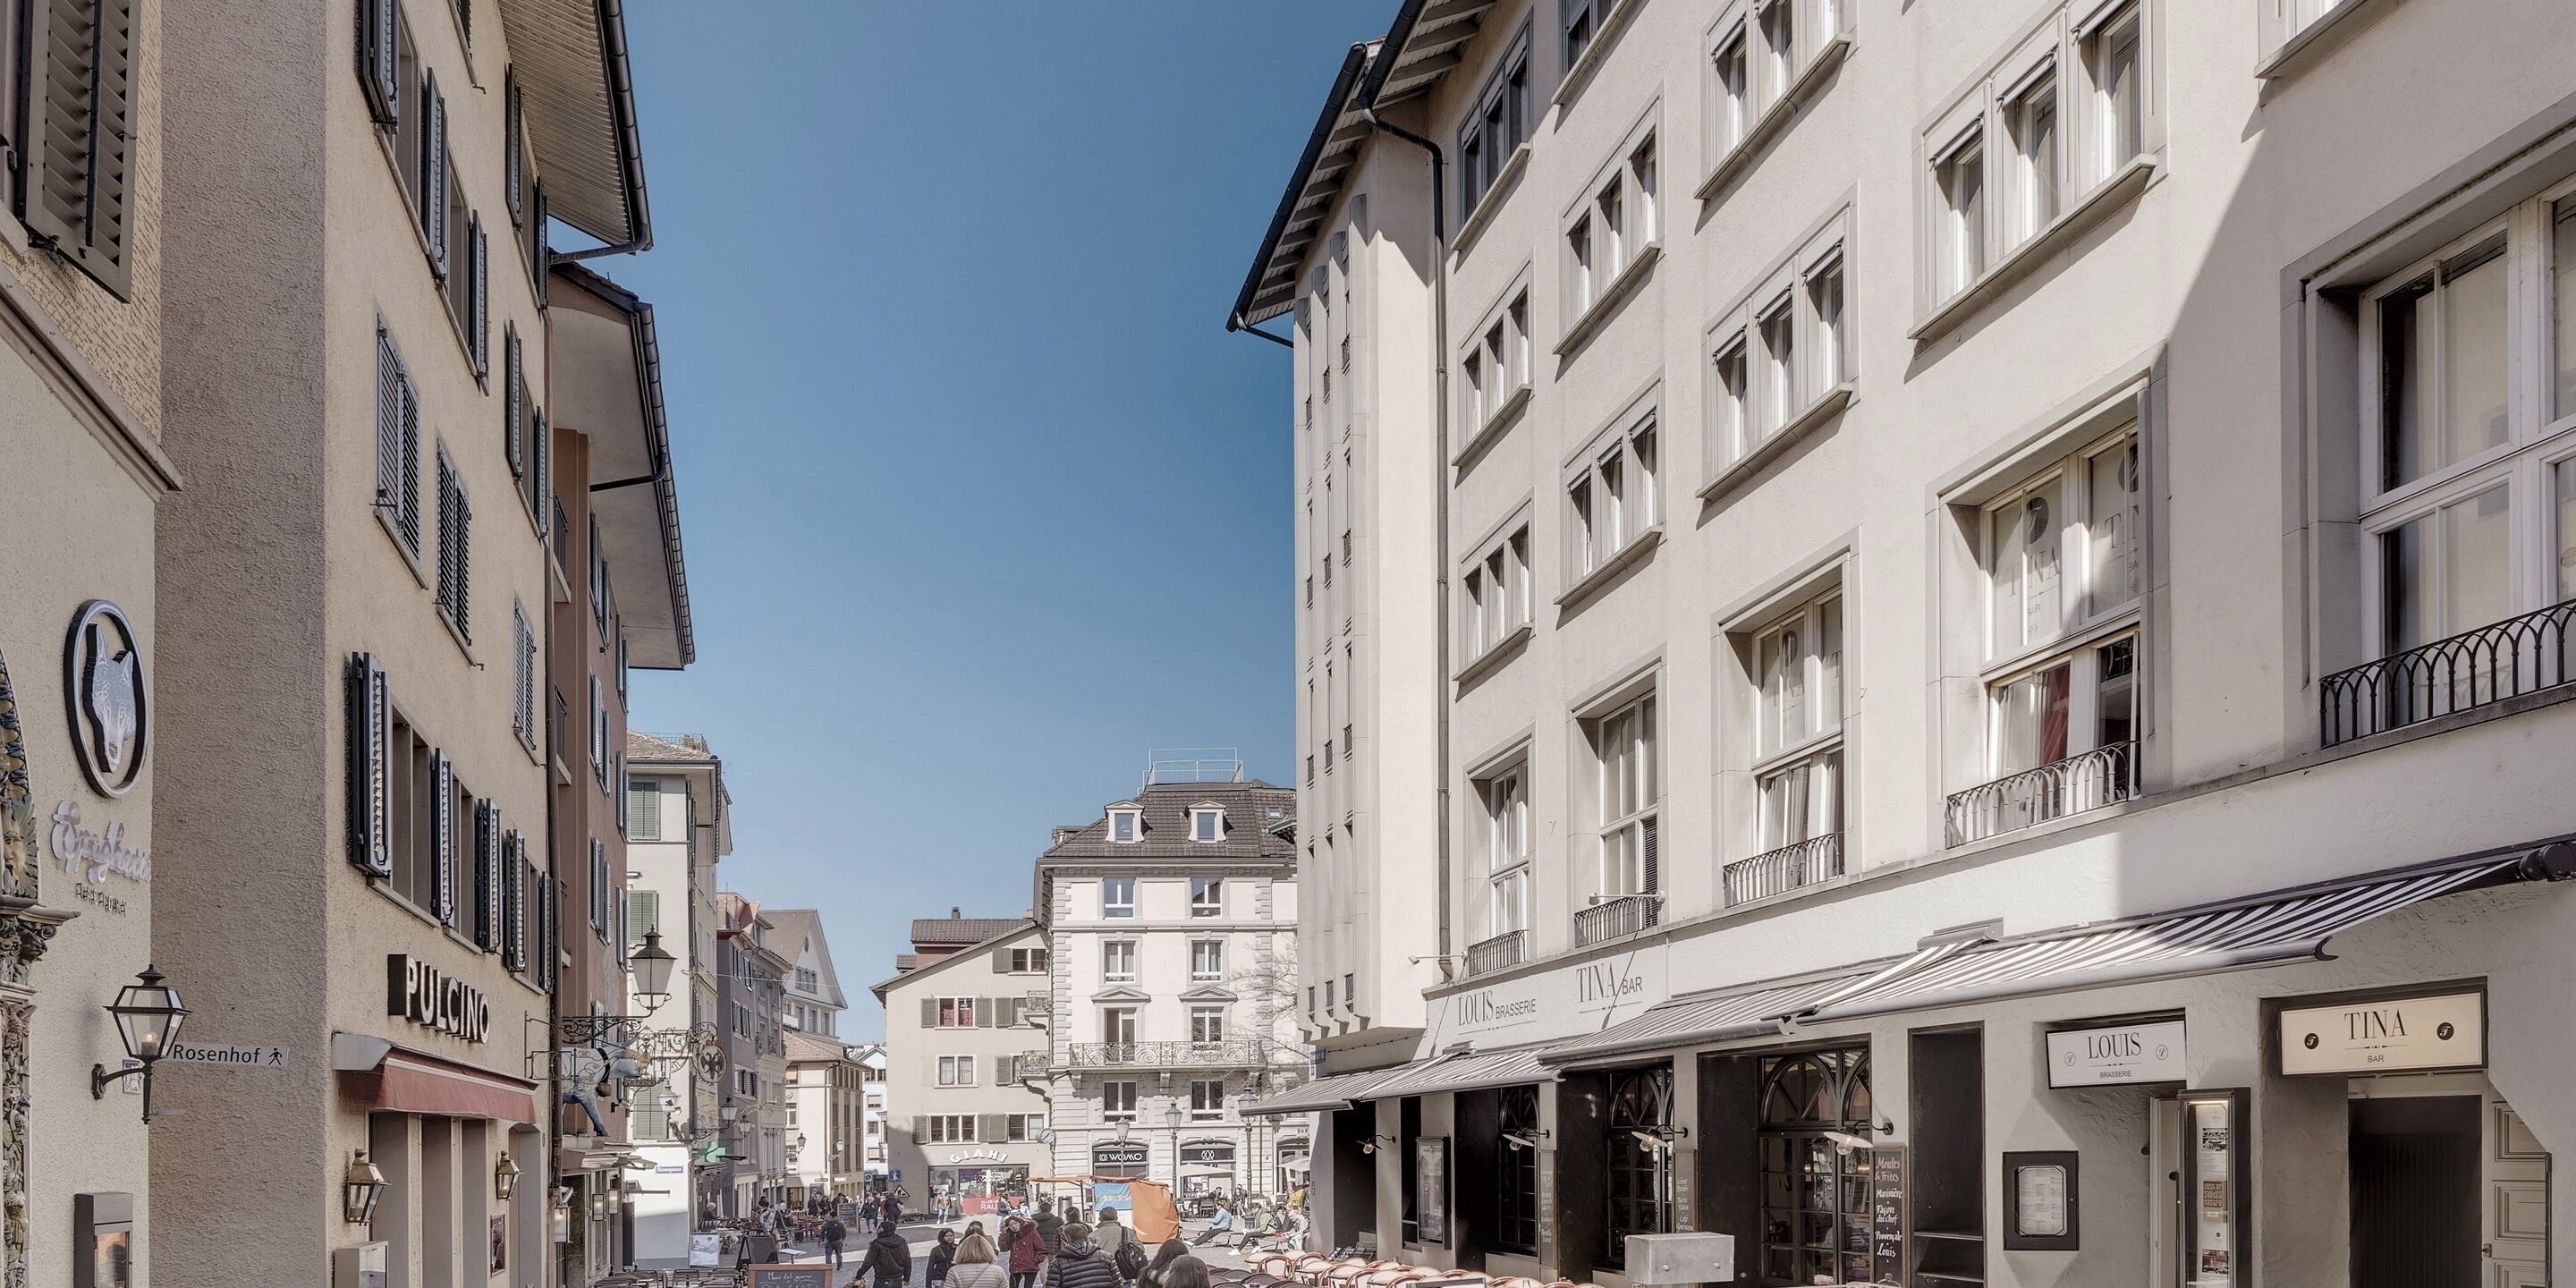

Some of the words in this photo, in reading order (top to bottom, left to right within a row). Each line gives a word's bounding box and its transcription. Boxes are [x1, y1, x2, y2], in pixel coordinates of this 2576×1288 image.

[1576, 962, 1617, 1002] TINA
[1622, 976, 1642, 995] BAR
[404, 954, 489, 1044] PULCINO
[1458, 990, 1494, 1026] LOUIS
[1496, 998, 1537, 1020] BRASSERIE
[2343, 1008, 2408, 1040] TINA
[2088, 1031, 2142, 1059] LOUIS
[173, 1044, 261, 1063] Rosenhof
[2368, 1055, 2385, 1063] BAR
[2100, 1070, 2132, 1079] BRASSERIE
[950, 1148, 1008, 1163] GIAHI
[1108, 1152, 1142, 1161] WOMO
[1876, 1157, 1901, 1169] Moules
[1876, 1214, 1885, 1223] du
[1885, 1215, 1899, 1225] chef
[1877, 1242, 1896, 1258] Louis
